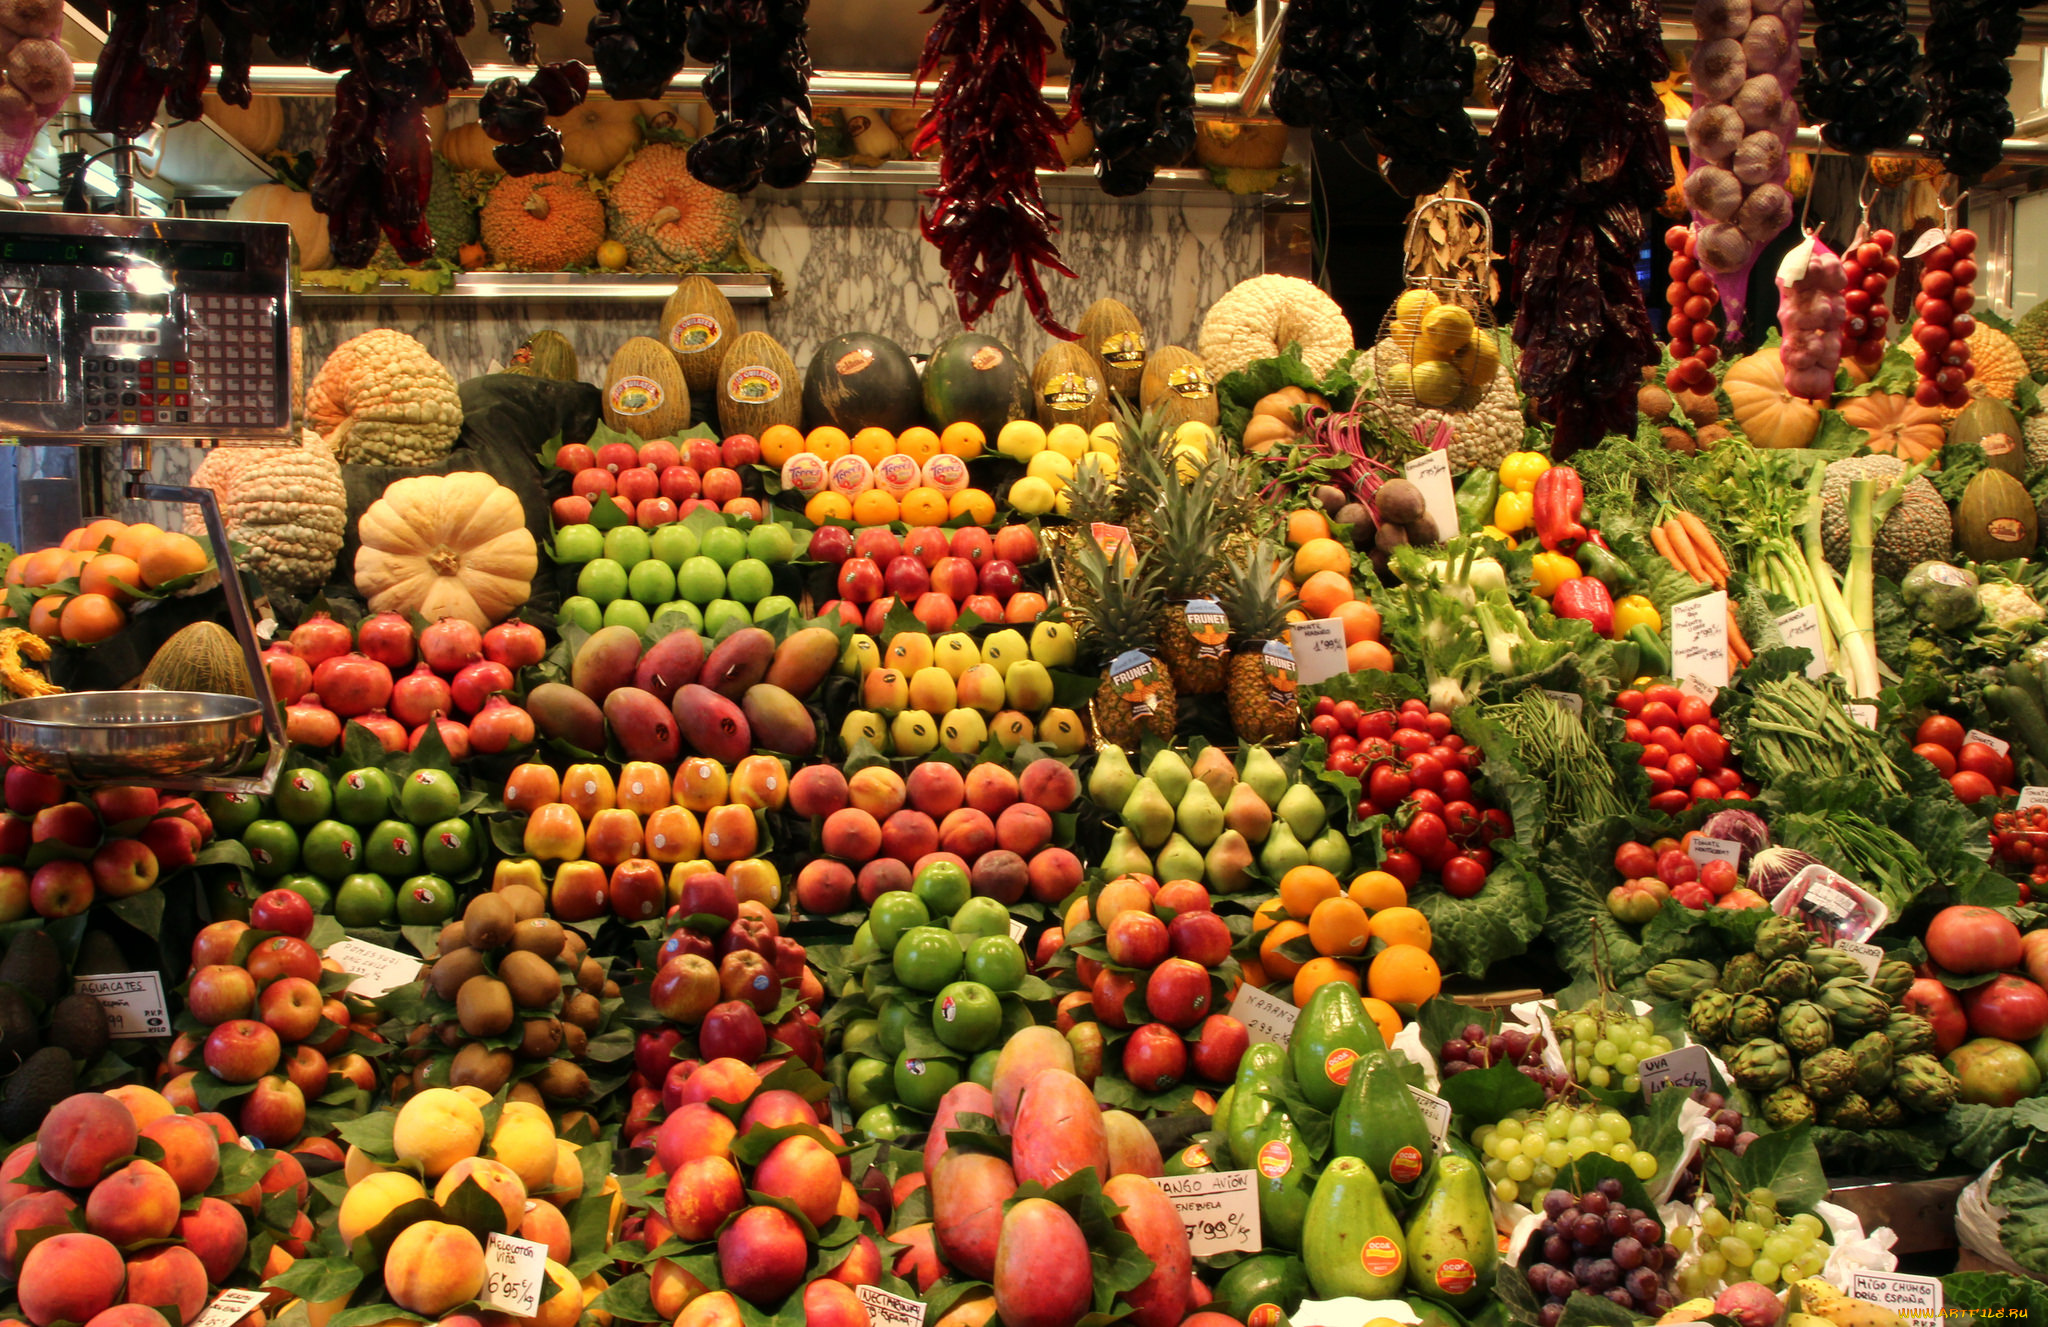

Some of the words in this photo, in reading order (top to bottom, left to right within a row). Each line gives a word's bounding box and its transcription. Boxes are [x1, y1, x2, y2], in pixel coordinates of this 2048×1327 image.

[1186, 613, 1226, 625] FRUNET
[1264, 654, 1297, 672] FRUNET
[1113, 662, 1154, 687] FRUNET
[80, 980, 143, 994] AGUACATES
[1246, 995, 1297, 1024] NARANJ
[1645, 1058, 1668, 1071] UVA
[1158, 1179, 1202, 1195] ANGO
[1174, 1201, 1222, 1212] ENEZUELA
[1368, 1242, 1392, 1250] OCOA
[1884, 1292, 1926, 1306] ESPAÑA
